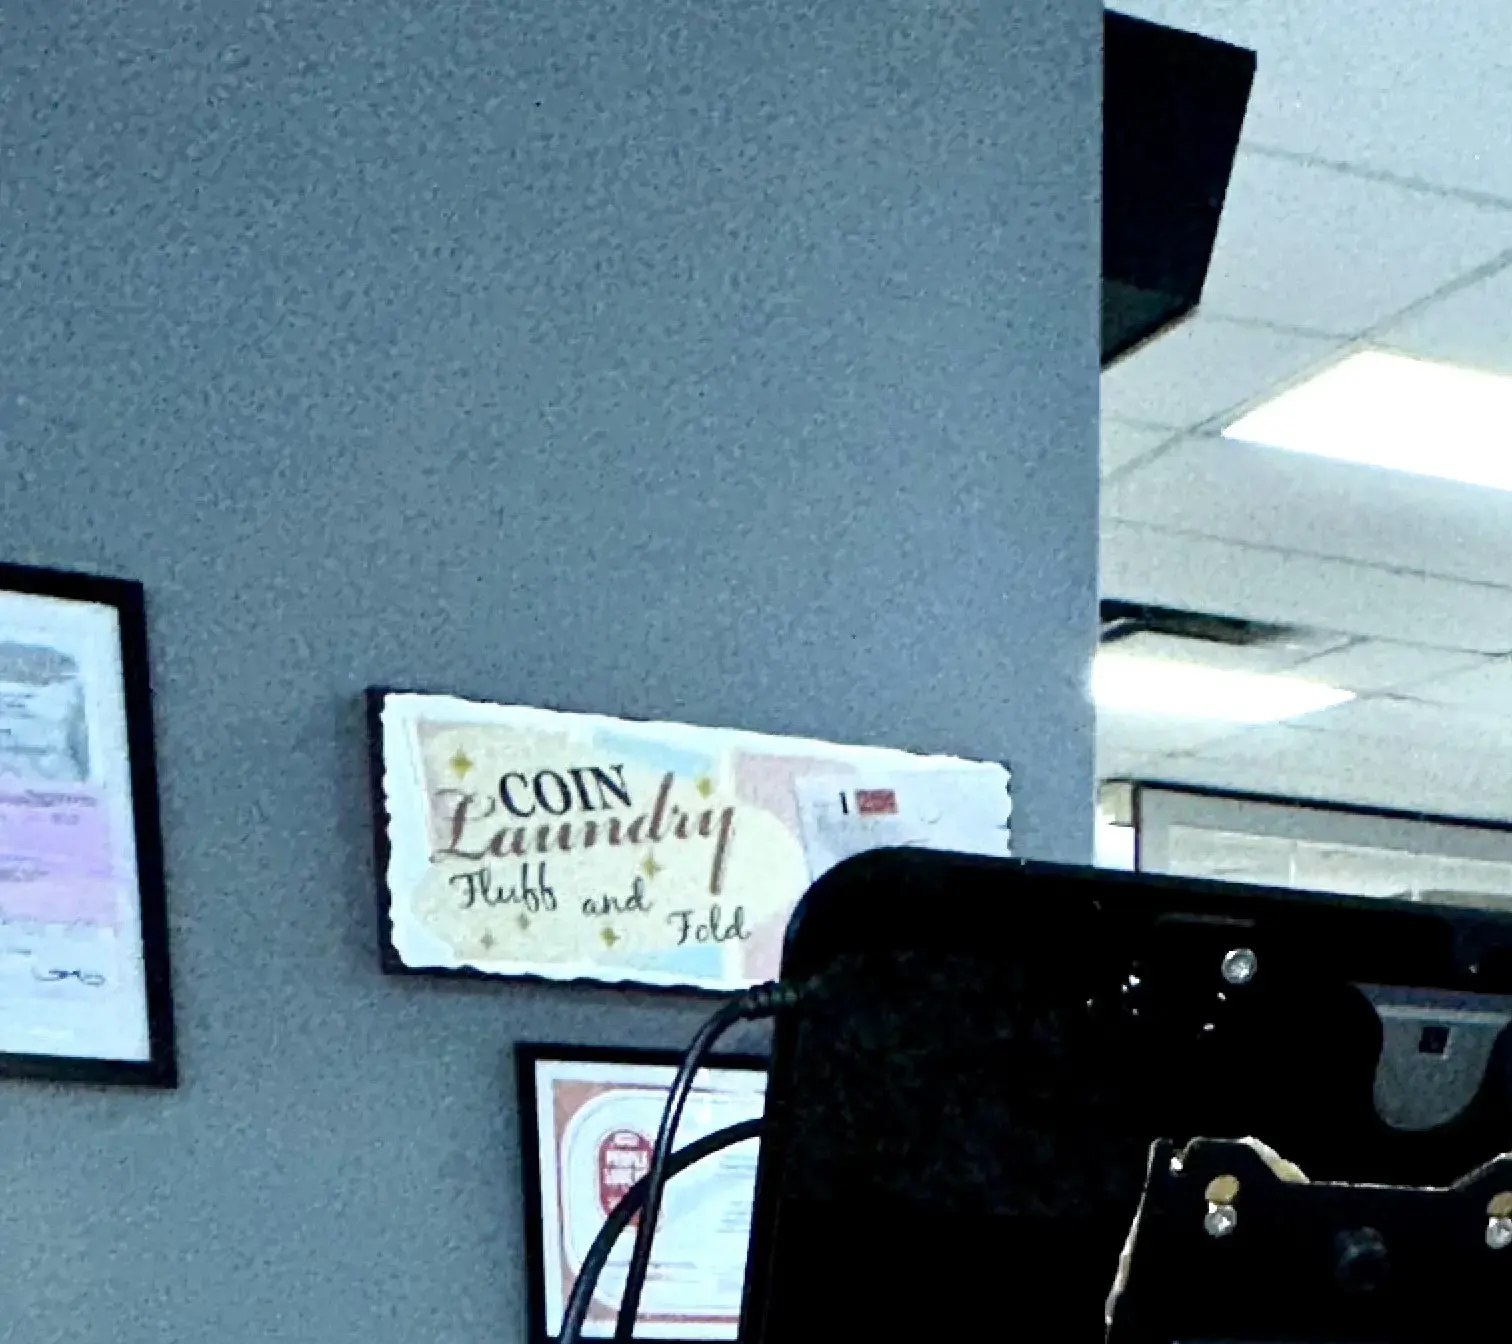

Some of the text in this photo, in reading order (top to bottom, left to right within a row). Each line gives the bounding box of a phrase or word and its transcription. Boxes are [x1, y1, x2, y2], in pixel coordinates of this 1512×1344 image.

[499, 764, 632, 817] COIN
[429, 771, 737, 895] Laundry
[449, 861, 751, 945] Fluff and Fold
